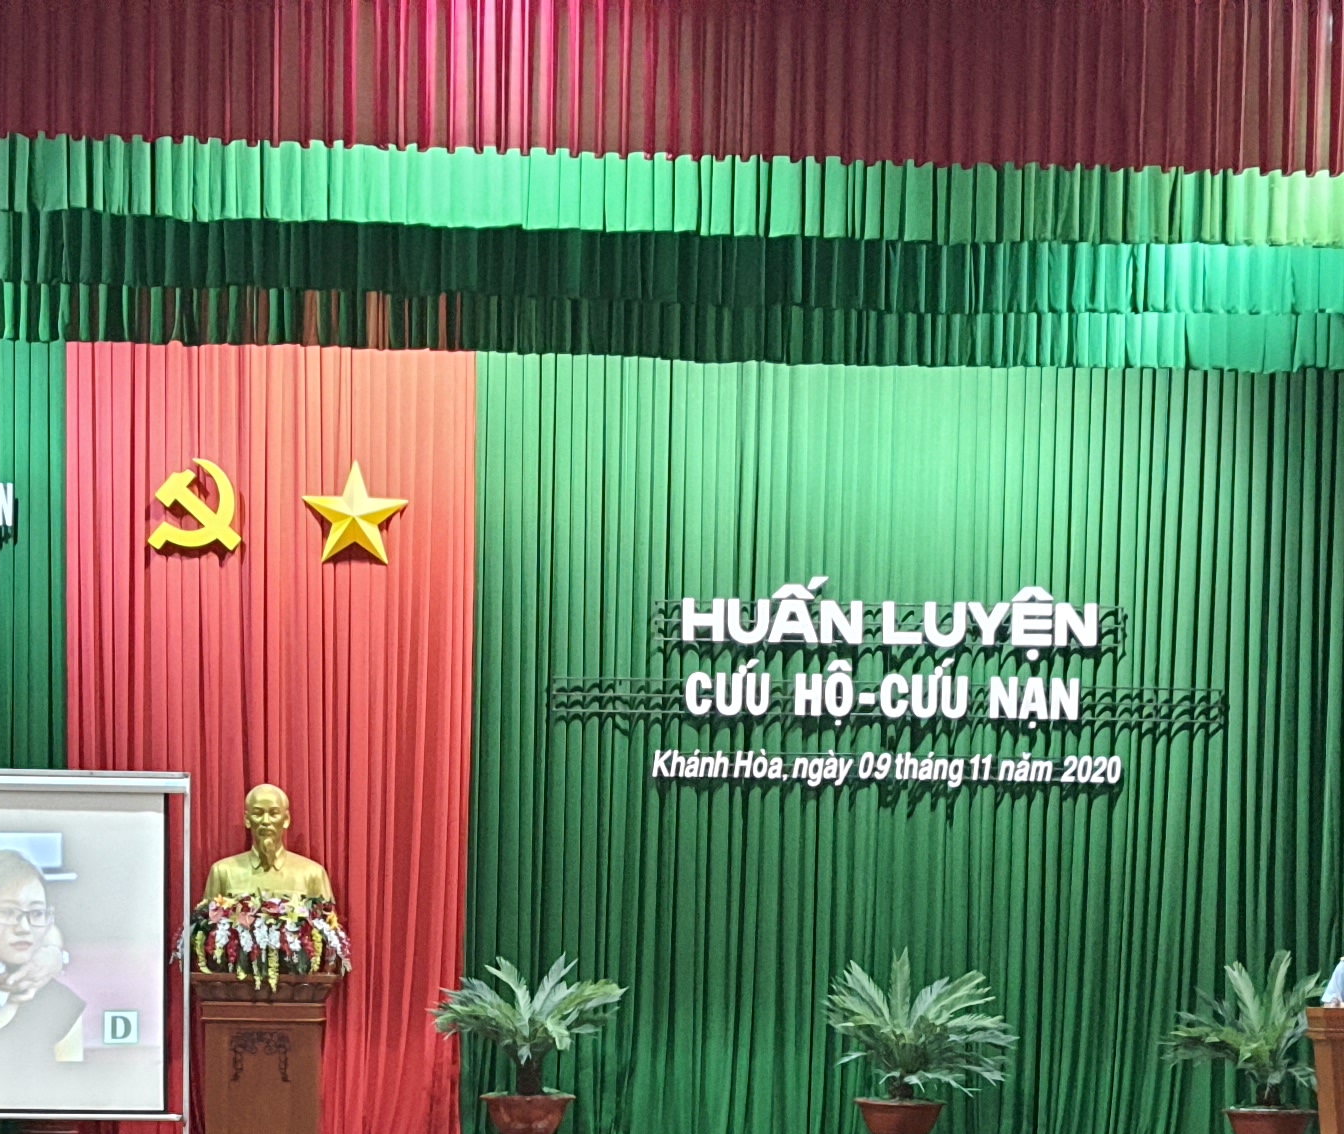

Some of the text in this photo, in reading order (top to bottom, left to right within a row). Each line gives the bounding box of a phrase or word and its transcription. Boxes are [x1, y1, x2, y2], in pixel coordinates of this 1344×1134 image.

[681, 576, 1098, 661] HUẤN LUYỆN
[685, 659, 771, 717] CỨU
[989, 676, 1081, 729] NẠN
[651, 748, 1122, 788] Khánh Hòa, ngày 09 tháng 11 năm 2020
[110, 1015, 132, 1039] D
